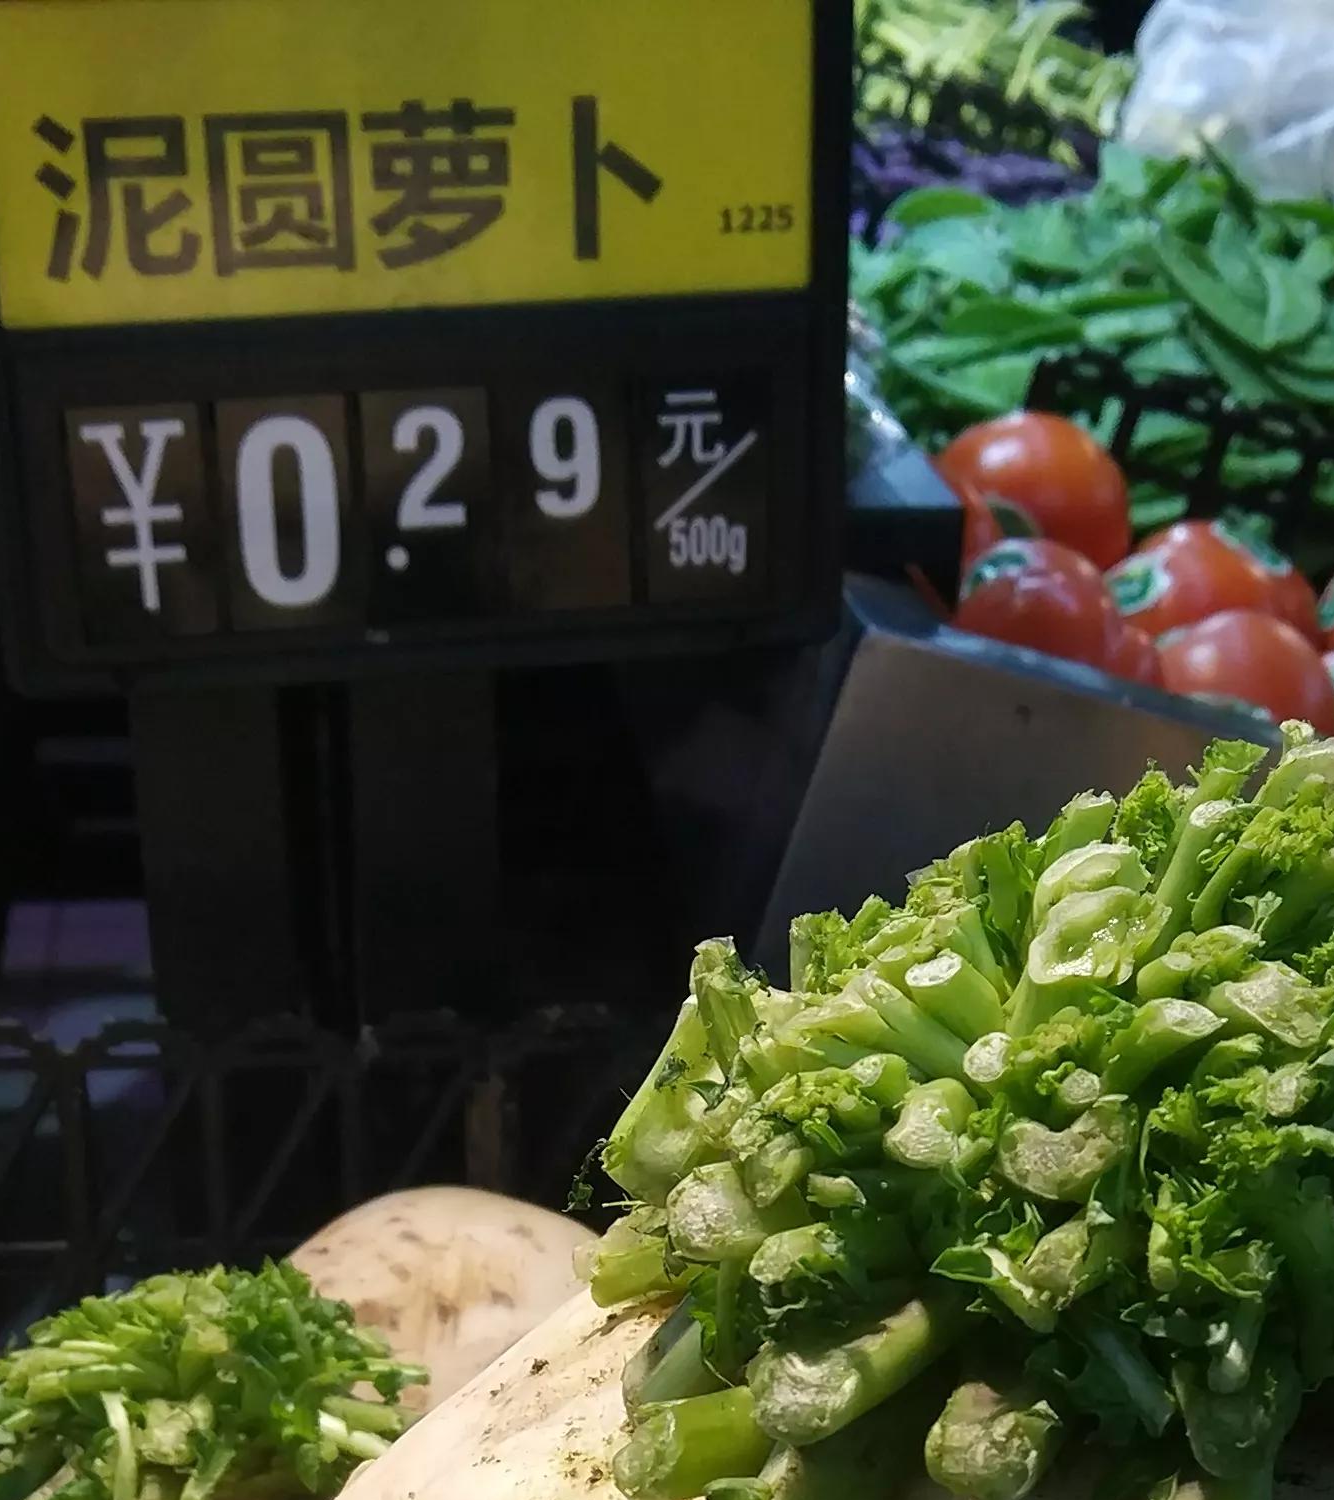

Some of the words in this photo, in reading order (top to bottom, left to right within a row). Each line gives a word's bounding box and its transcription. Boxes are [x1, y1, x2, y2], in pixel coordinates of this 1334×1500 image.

[32, 95, 662, 283] 泥圆萝卜
[719, 205, 795, 235] 1225
